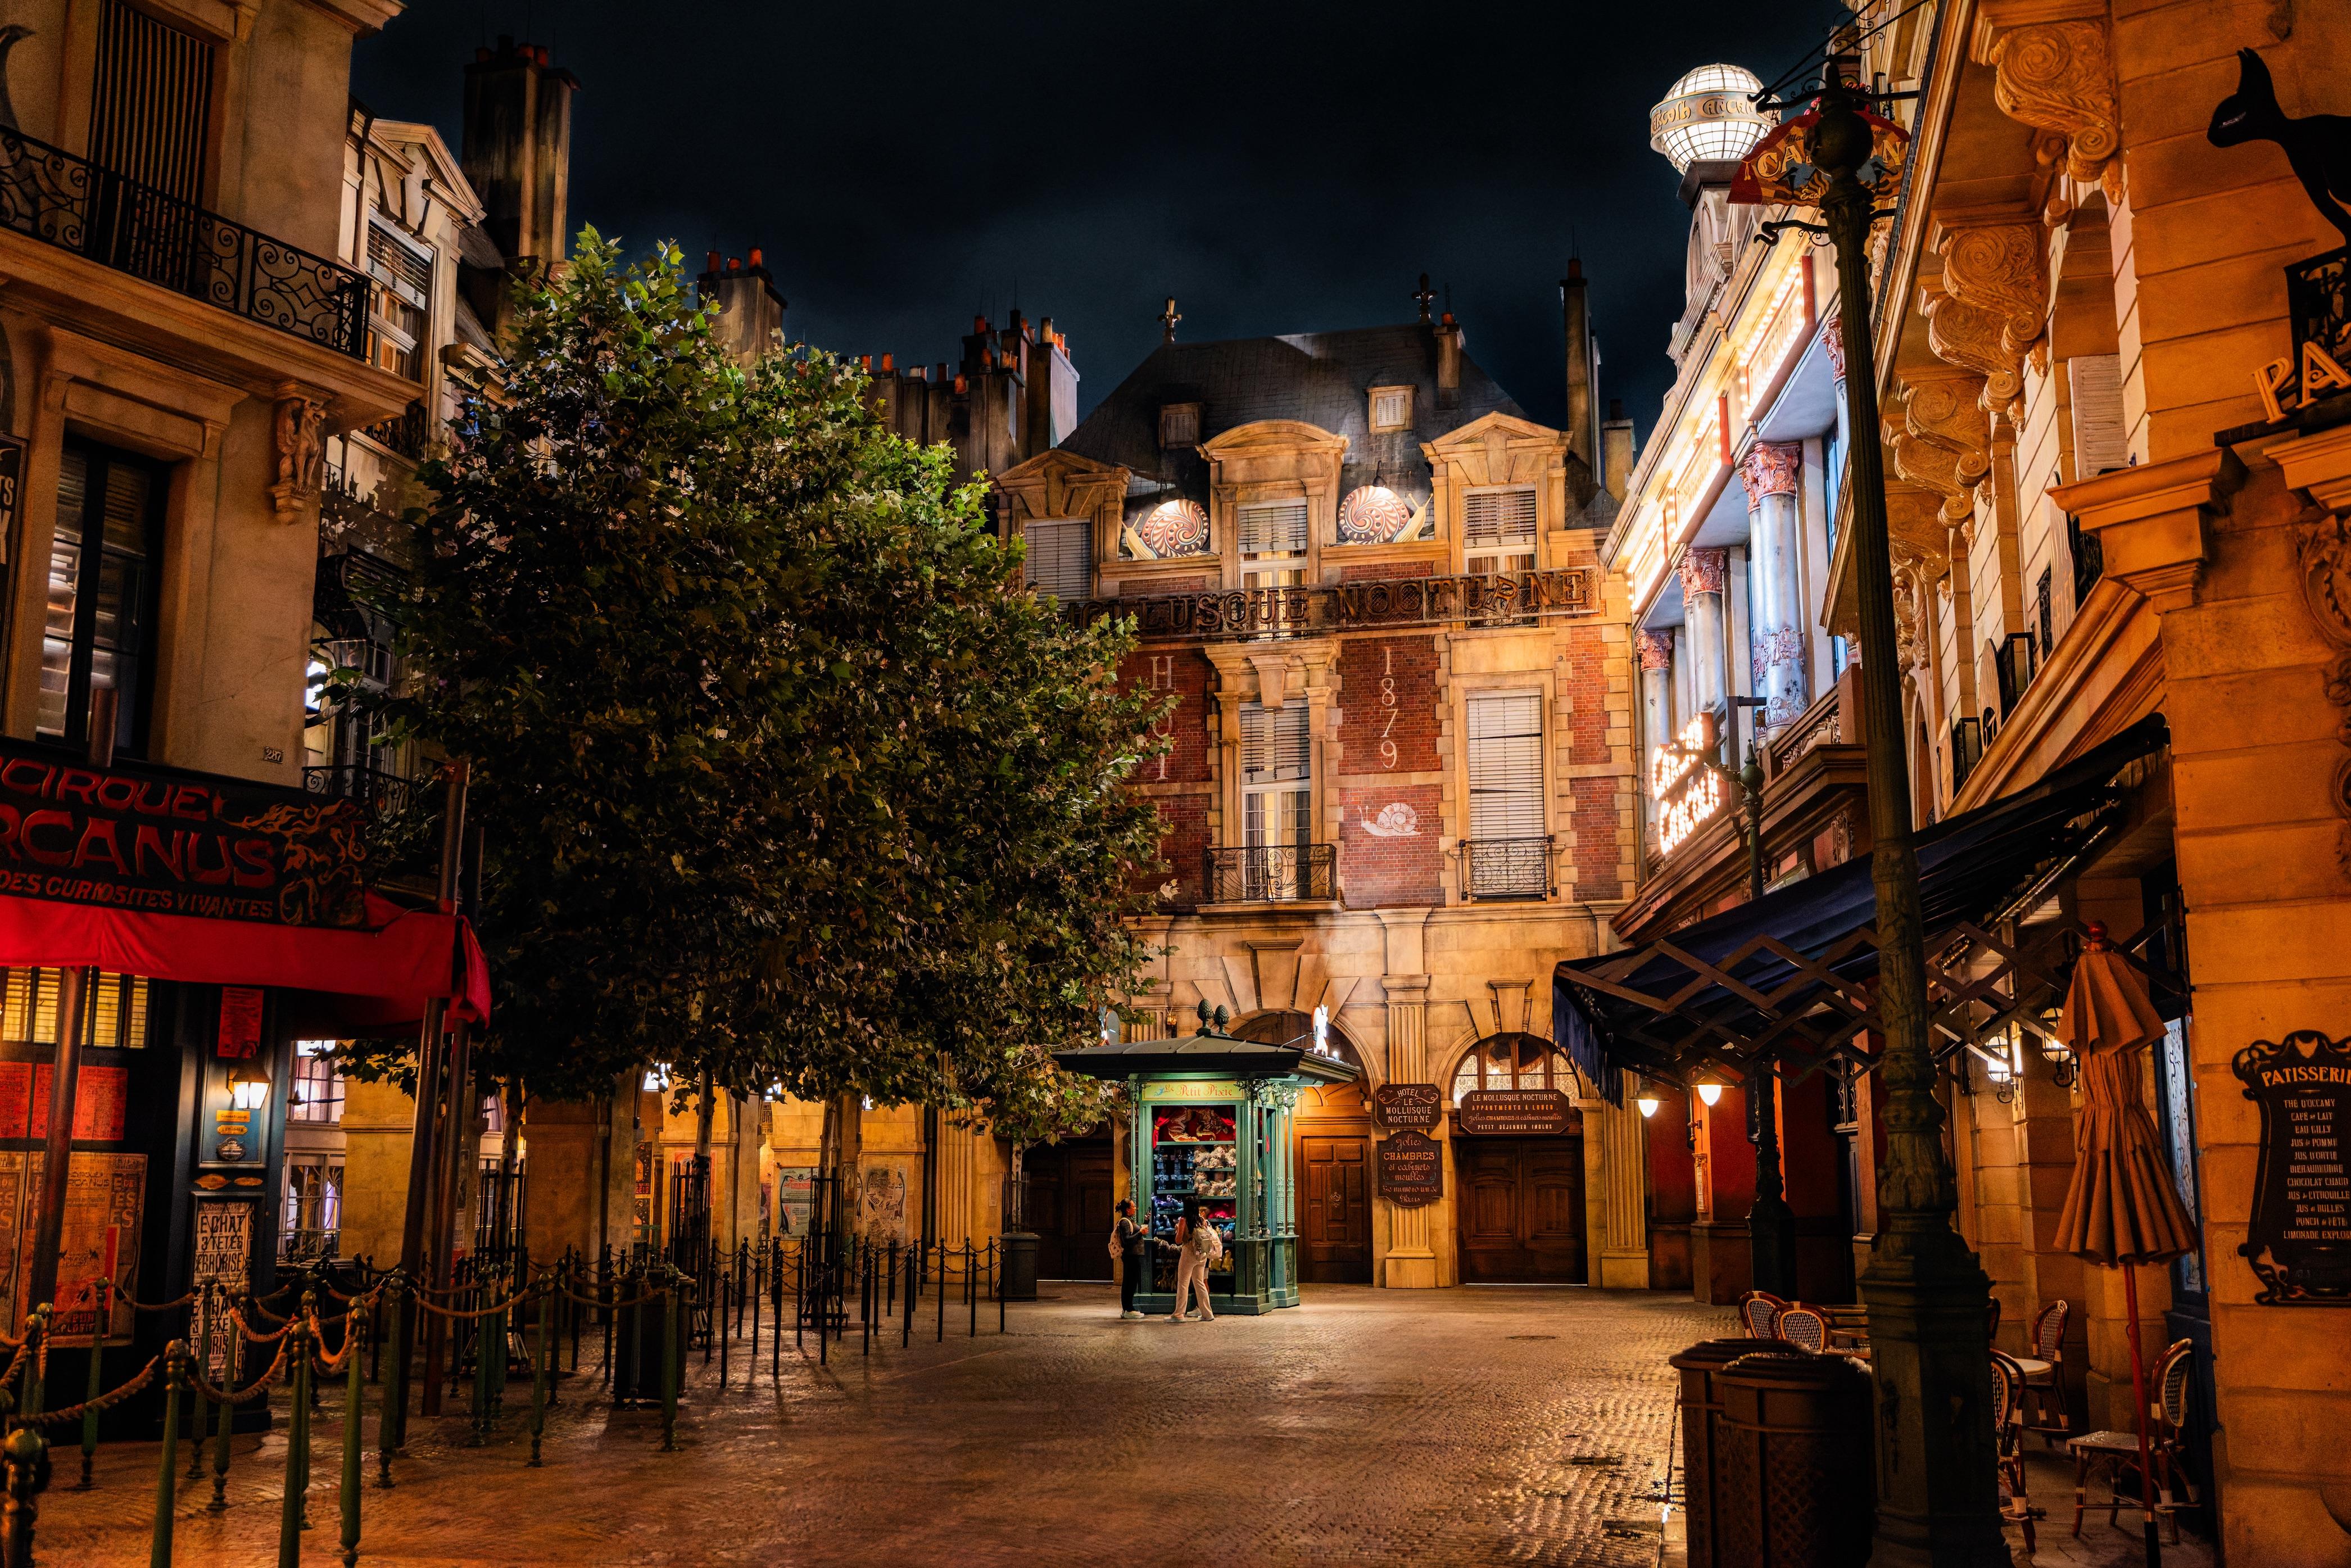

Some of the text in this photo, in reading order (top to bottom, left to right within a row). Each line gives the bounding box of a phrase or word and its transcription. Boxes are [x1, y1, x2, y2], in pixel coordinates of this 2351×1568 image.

[1336, 570, 1588, 618] NOCTURNE
[1380, 647, 1398, 768] 1879
[265, 749, 281, 761] 287
[2, 758, 209, 821] CIRQUE
[1176, 1084, 1201, 1096] Petit
[1204, 1084, 1232, 1096] Pixie
[1397, 1089, 1419, 1097] HOTEL
[2295, 1151, 2307, 1160] JUS
[1398, 1161, 1430, 1171] cabinets
[2287, 1177, 2348, 1186] CHOCOLAT CHAUD
[2287, 1191, 2300, 1200] JUS
[2309, 1190, 2350, 1200] CITROUILLE
[2296, 1204, 2308, 1213] JUS
[211, 1214, 245, 1233] CHAT
[2296, 1217, 2318, 1226] PUNCH
[2284, 1230, 2318, 1239] LIMONADE
